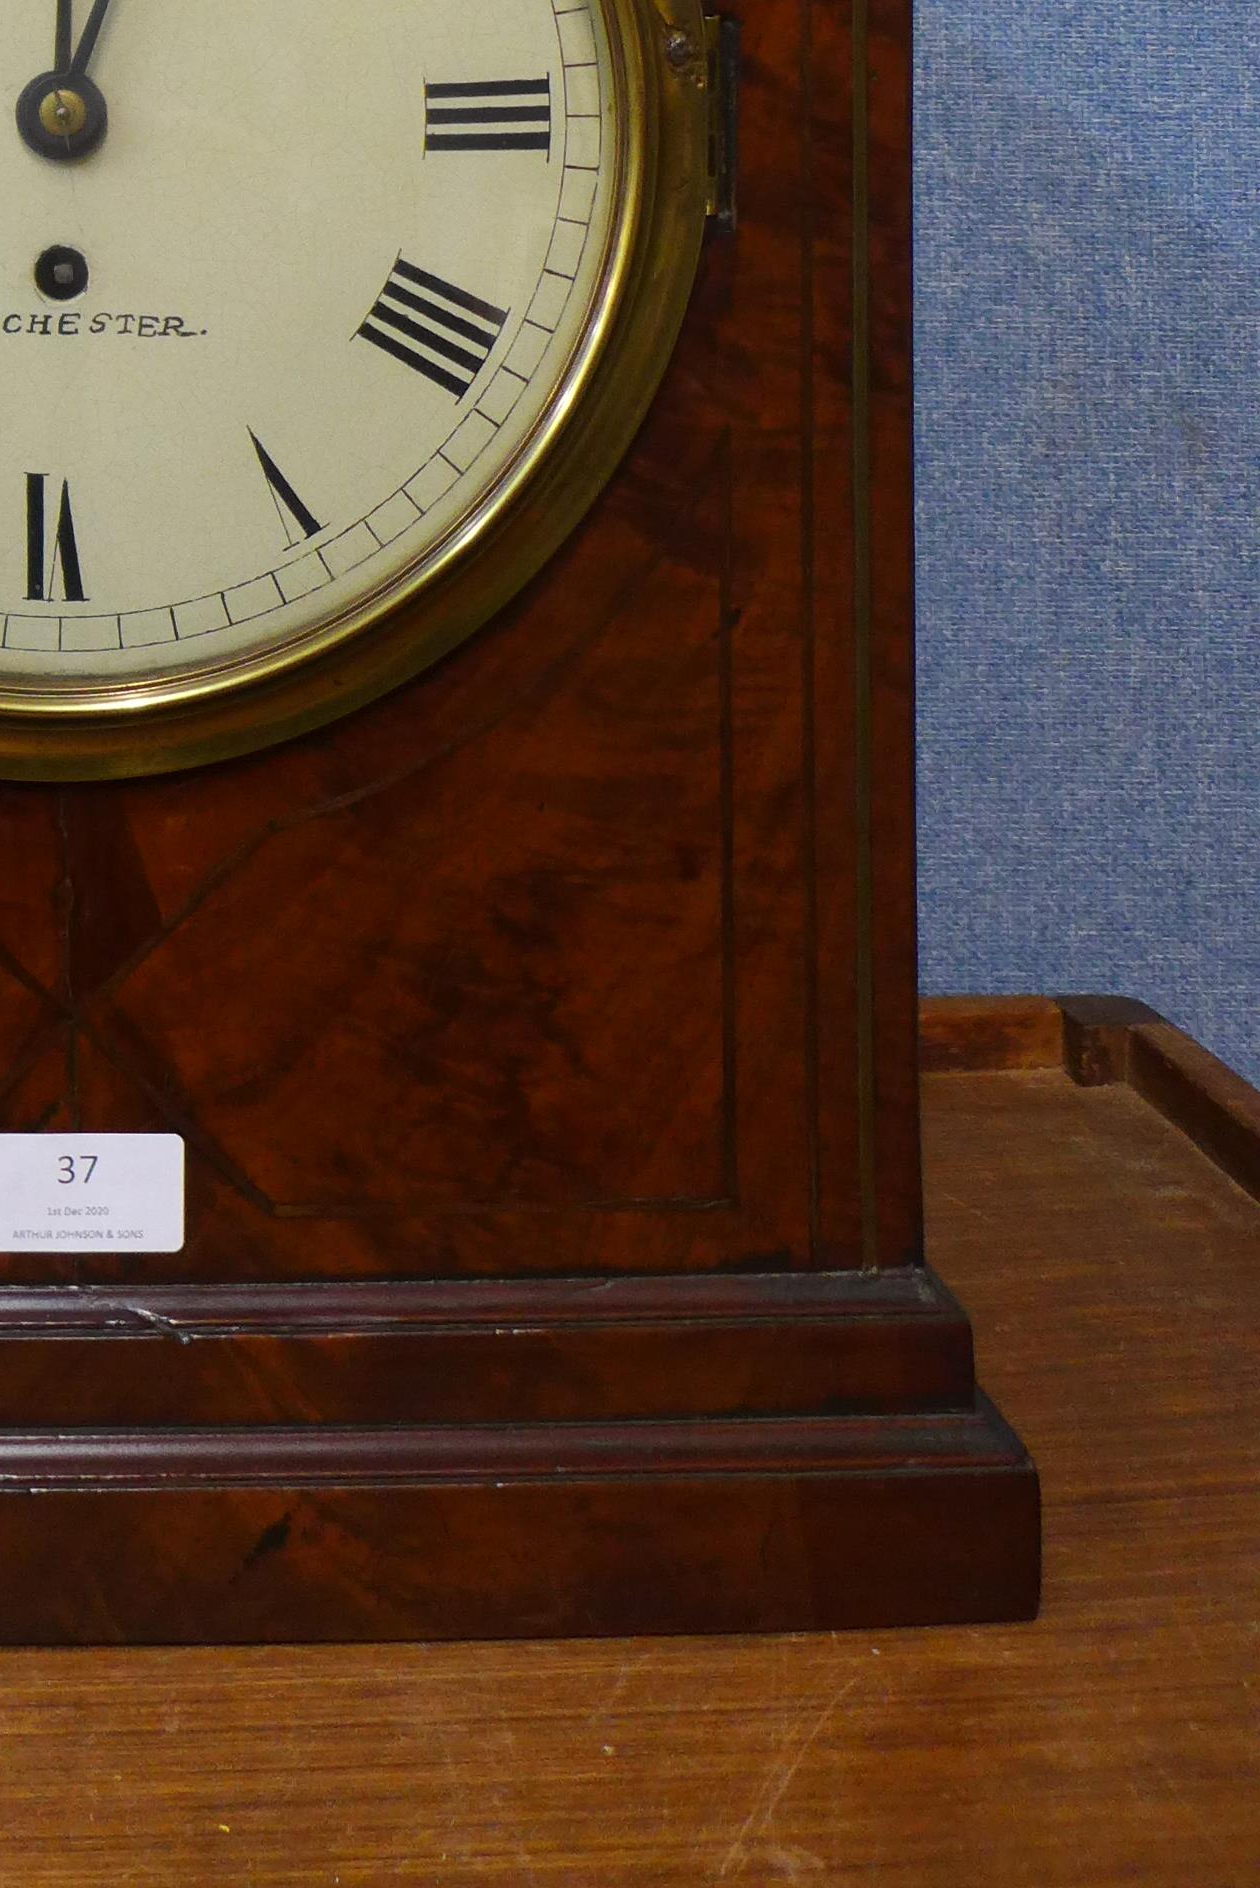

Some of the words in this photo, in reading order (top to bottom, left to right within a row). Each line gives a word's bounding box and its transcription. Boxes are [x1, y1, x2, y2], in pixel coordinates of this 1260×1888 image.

[422, 70, 550, 163] III
[245, 424, 330, 552] V
[57, 1155, 99, 1185] 37
[47, 1206, 62, 1217] 1st
[64, 1206, 83, 1217] Dec
[85, 1206, 110, 1217] 2020
[12, 1229, 53, 1240] ARTHUR
[55, 1229, 103, 1240] JOHNSON
[106, 1229, 114, 1240] &
[117, 1229, 144, 1240] SONS
